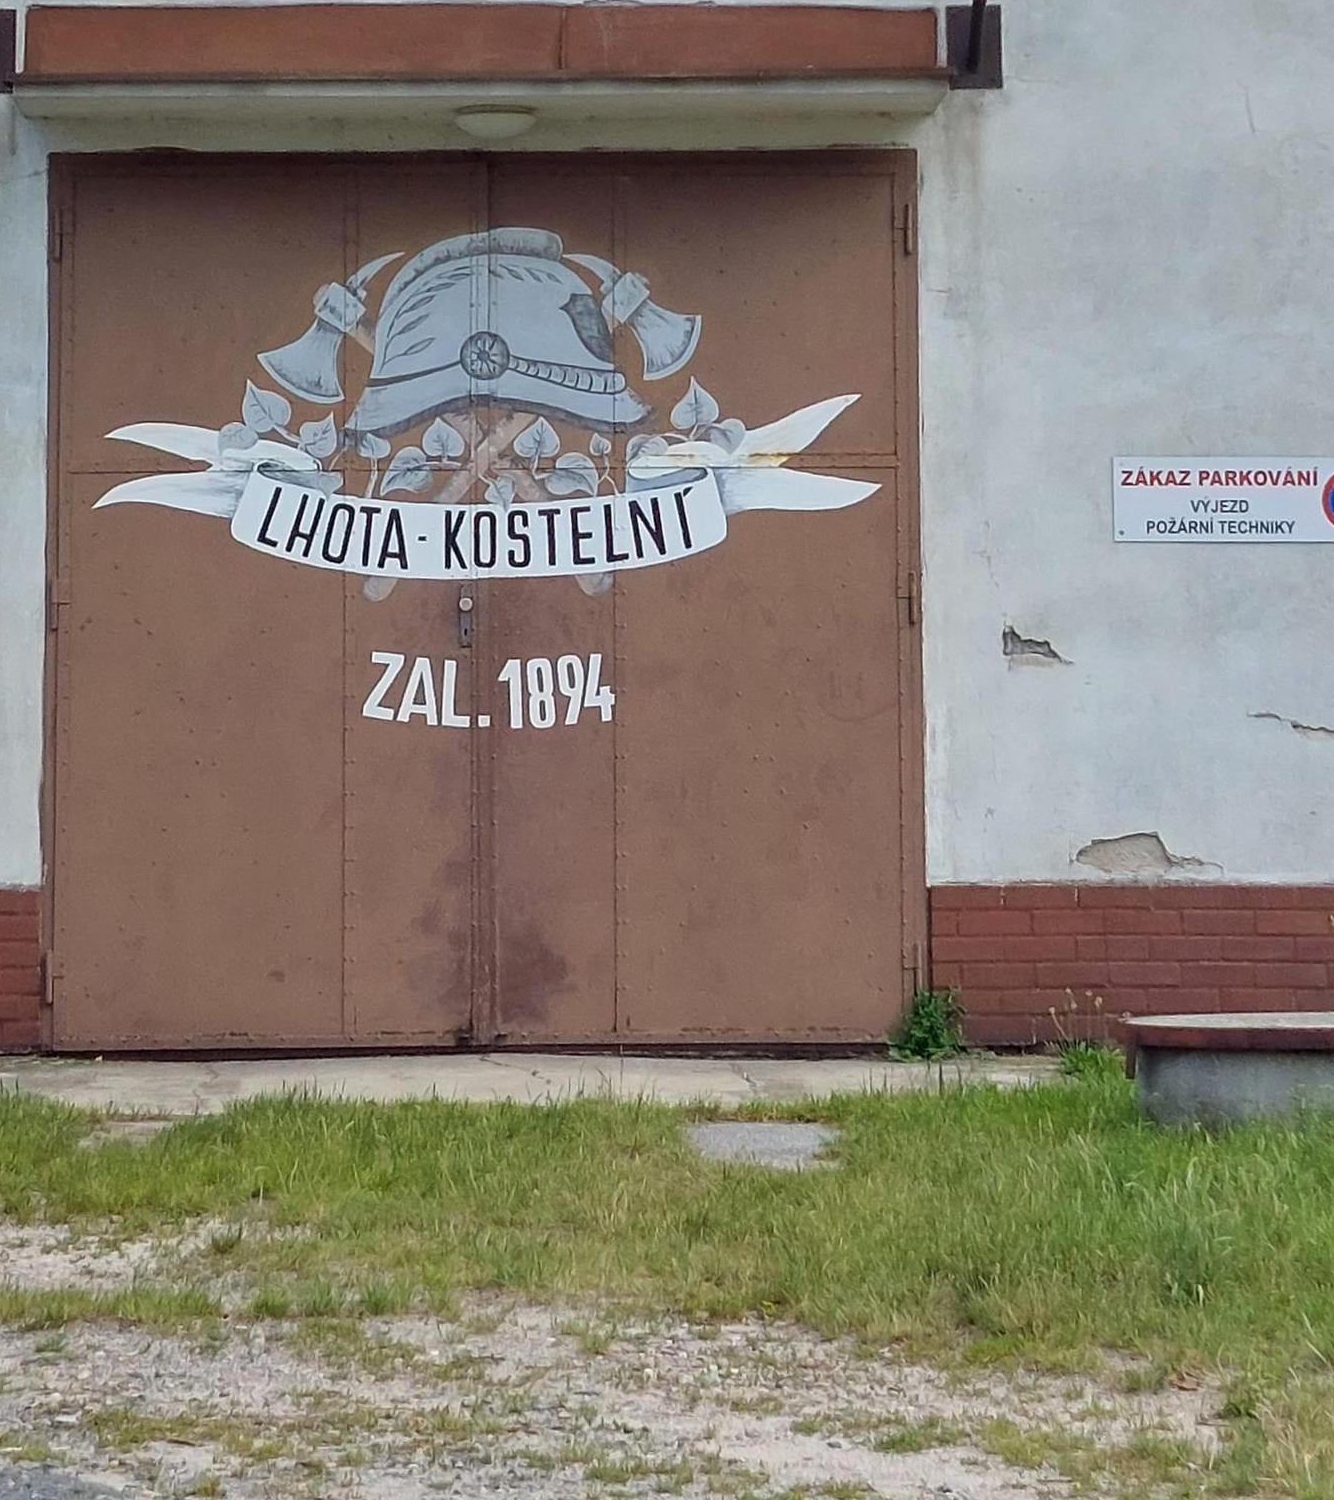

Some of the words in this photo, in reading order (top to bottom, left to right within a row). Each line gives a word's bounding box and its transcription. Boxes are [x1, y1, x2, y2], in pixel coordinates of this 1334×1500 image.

[1120, 466, 1191, 487] ZÁKAZ
[1198, 466, 1319, 487] PARKOVÁNÍ
[1190, 497, 1249, 514] VÝJEZD
[1146, 516, 1214, 535] POŽÁRNÍ
[1218, 519, 1296, 535] TECHNIKY
[361, 651, 491, 729] ZAL.
[498, 653, 616, 730] 1894
